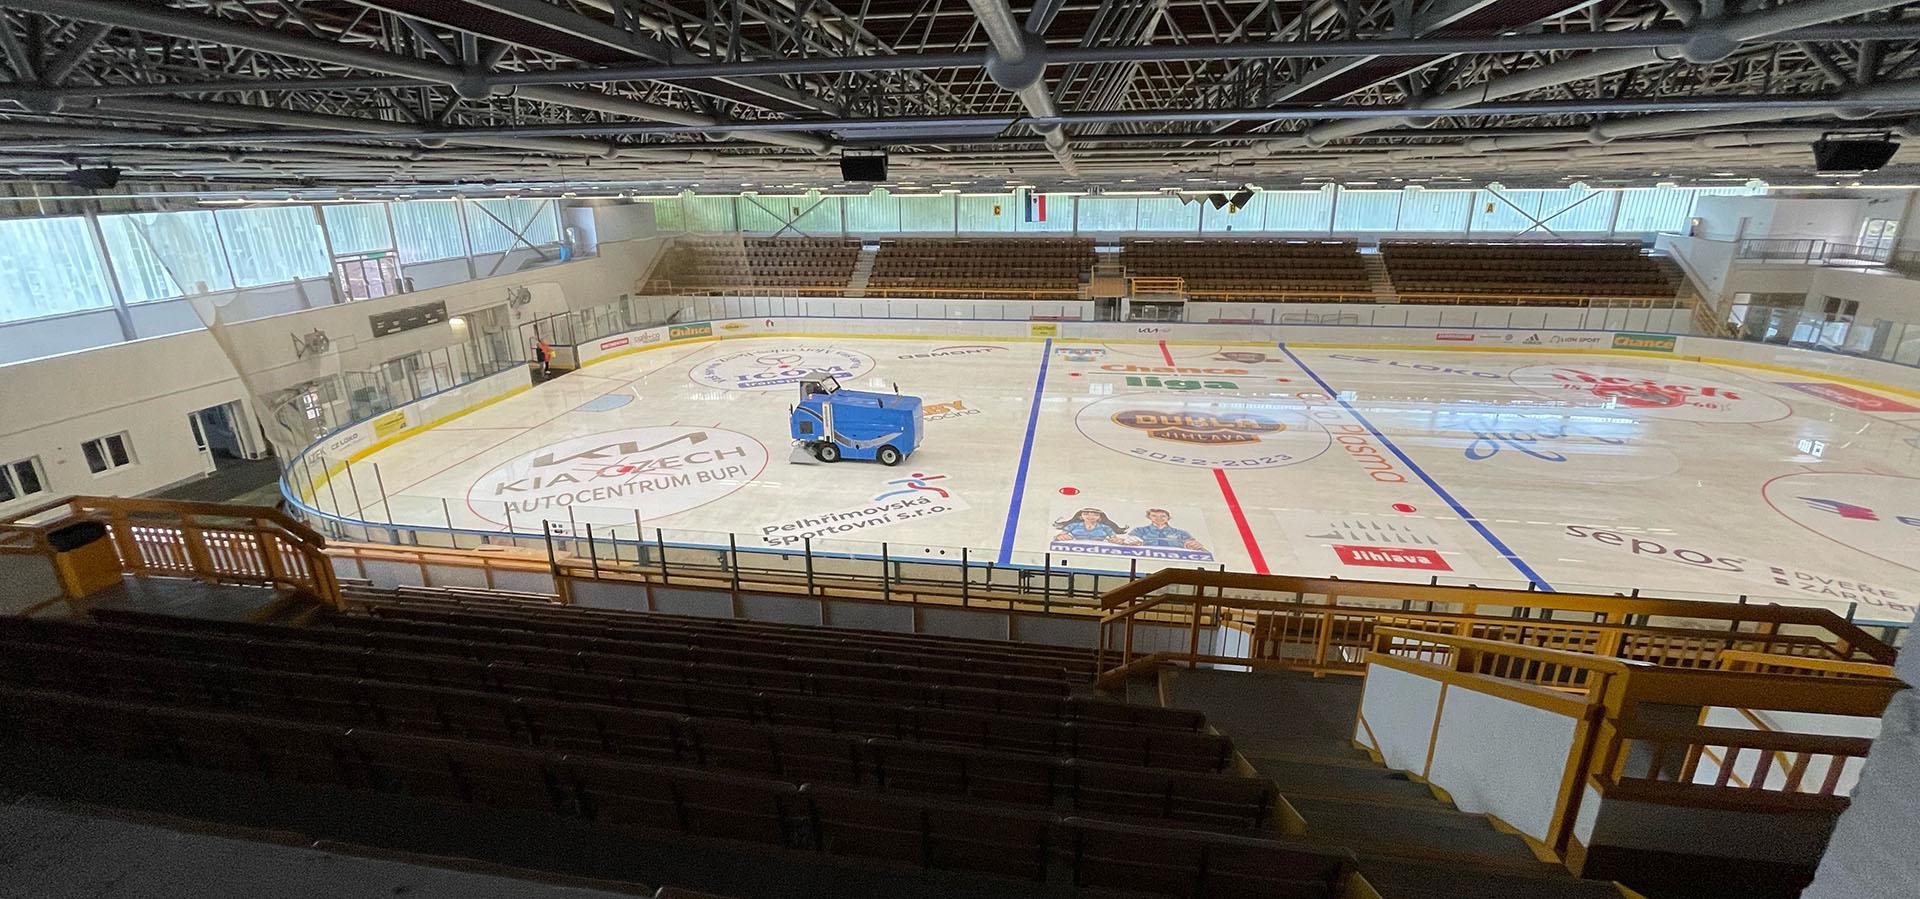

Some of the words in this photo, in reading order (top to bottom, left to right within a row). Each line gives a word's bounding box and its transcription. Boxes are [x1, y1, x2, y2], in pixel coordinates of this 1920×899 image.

[669, 328, 711, 338] Chance
[1615, 336, 1675, 349] Chance
[898, 348, 993, 360] OSMONT
[736, 365, 843, 382] ICOM
[1389, 361, 1501, 379] LOKO
[1125, 376, 1240, 390] liga
[1134, 414, 1264, 429] DUKLA
[1160, 430, 1246, 442] JIHLAVA
[1130, 447, 1293, 468] 2022-2023
[1323, 423, 1409, 483] plasma
[494, 472, 579, 496] KIA
[596, 446, 747, 478] CZECH
[503, 473, 692, 517] AUTOCENTRUM
[698, 464, 749, 484] BUPI
[762, 495, 932, 536] Pelhřimovská
[768, 513, 892, 547] sportovní
[897, 505, 952, 521] s.r.o.
[1051, 544, 1213, 562] modra-vlna.cz
[1352, 550, 1432, 565] Jihlava
[1566, 525, 1745, 573] sepos
